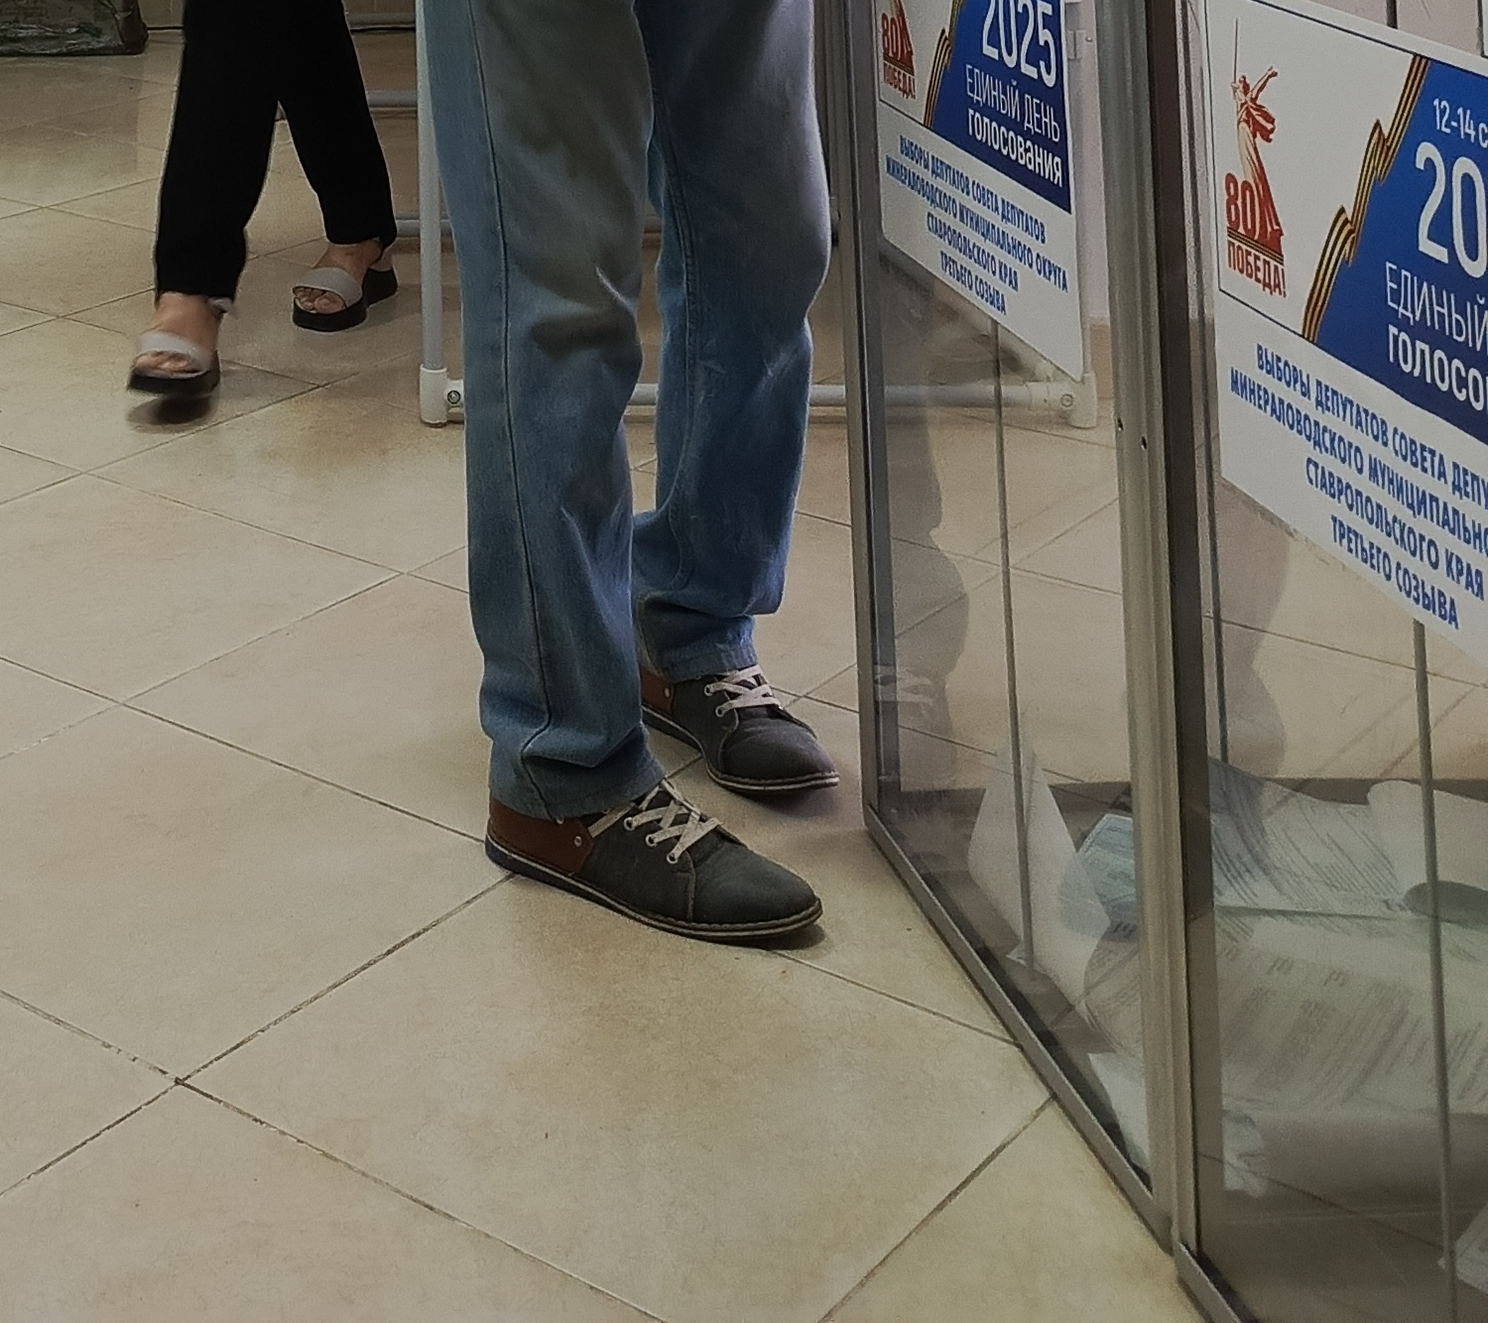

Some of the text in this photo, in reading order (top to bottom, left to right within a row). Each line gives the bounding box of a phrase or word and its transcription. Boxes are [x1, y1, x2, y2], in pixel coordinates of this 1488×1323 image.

[965, 64, 1060, 142] ЕДИНЫЙ ДЕНЬ
[1433, 98, 1476, 143] 12-14
[899, 135, 1046, 245] ВЫБОРЫ ДЕПУТАТОВ СОВЕТА ДЕПУТАТОВ
[1225, 172, 1257, 241] 80
[1415, 141, 1487, 279] 20
[926, 211, 1019, 292] СТАВРОПОЛЬСКОГО КРАЯ
[940, 250, 1007, 315] ТРЕТЬЕГО СОЗЫВА
[958, 202, 1034, 269] МУНИЦИПАЛЬНОГО
[1035, 252, 1069, 293] ОКРУГА
[1227, 239, 1287, 298] ПОБЕДА!
[1230, 366, 1364, 476] МИНЕРАЛОВОДСКОГО
[1256, 343, 1488, 510] ВЫБОРЫ ДЕПУТАТОВ СОВЕТА ДЕПУ
[1305, 456, 1484, 602] СТАВРОПОЛЬСКОГО КРАЯ
[1331, 514, 1460, 630] ТРЕТЬЕГО СОЗЫВА
